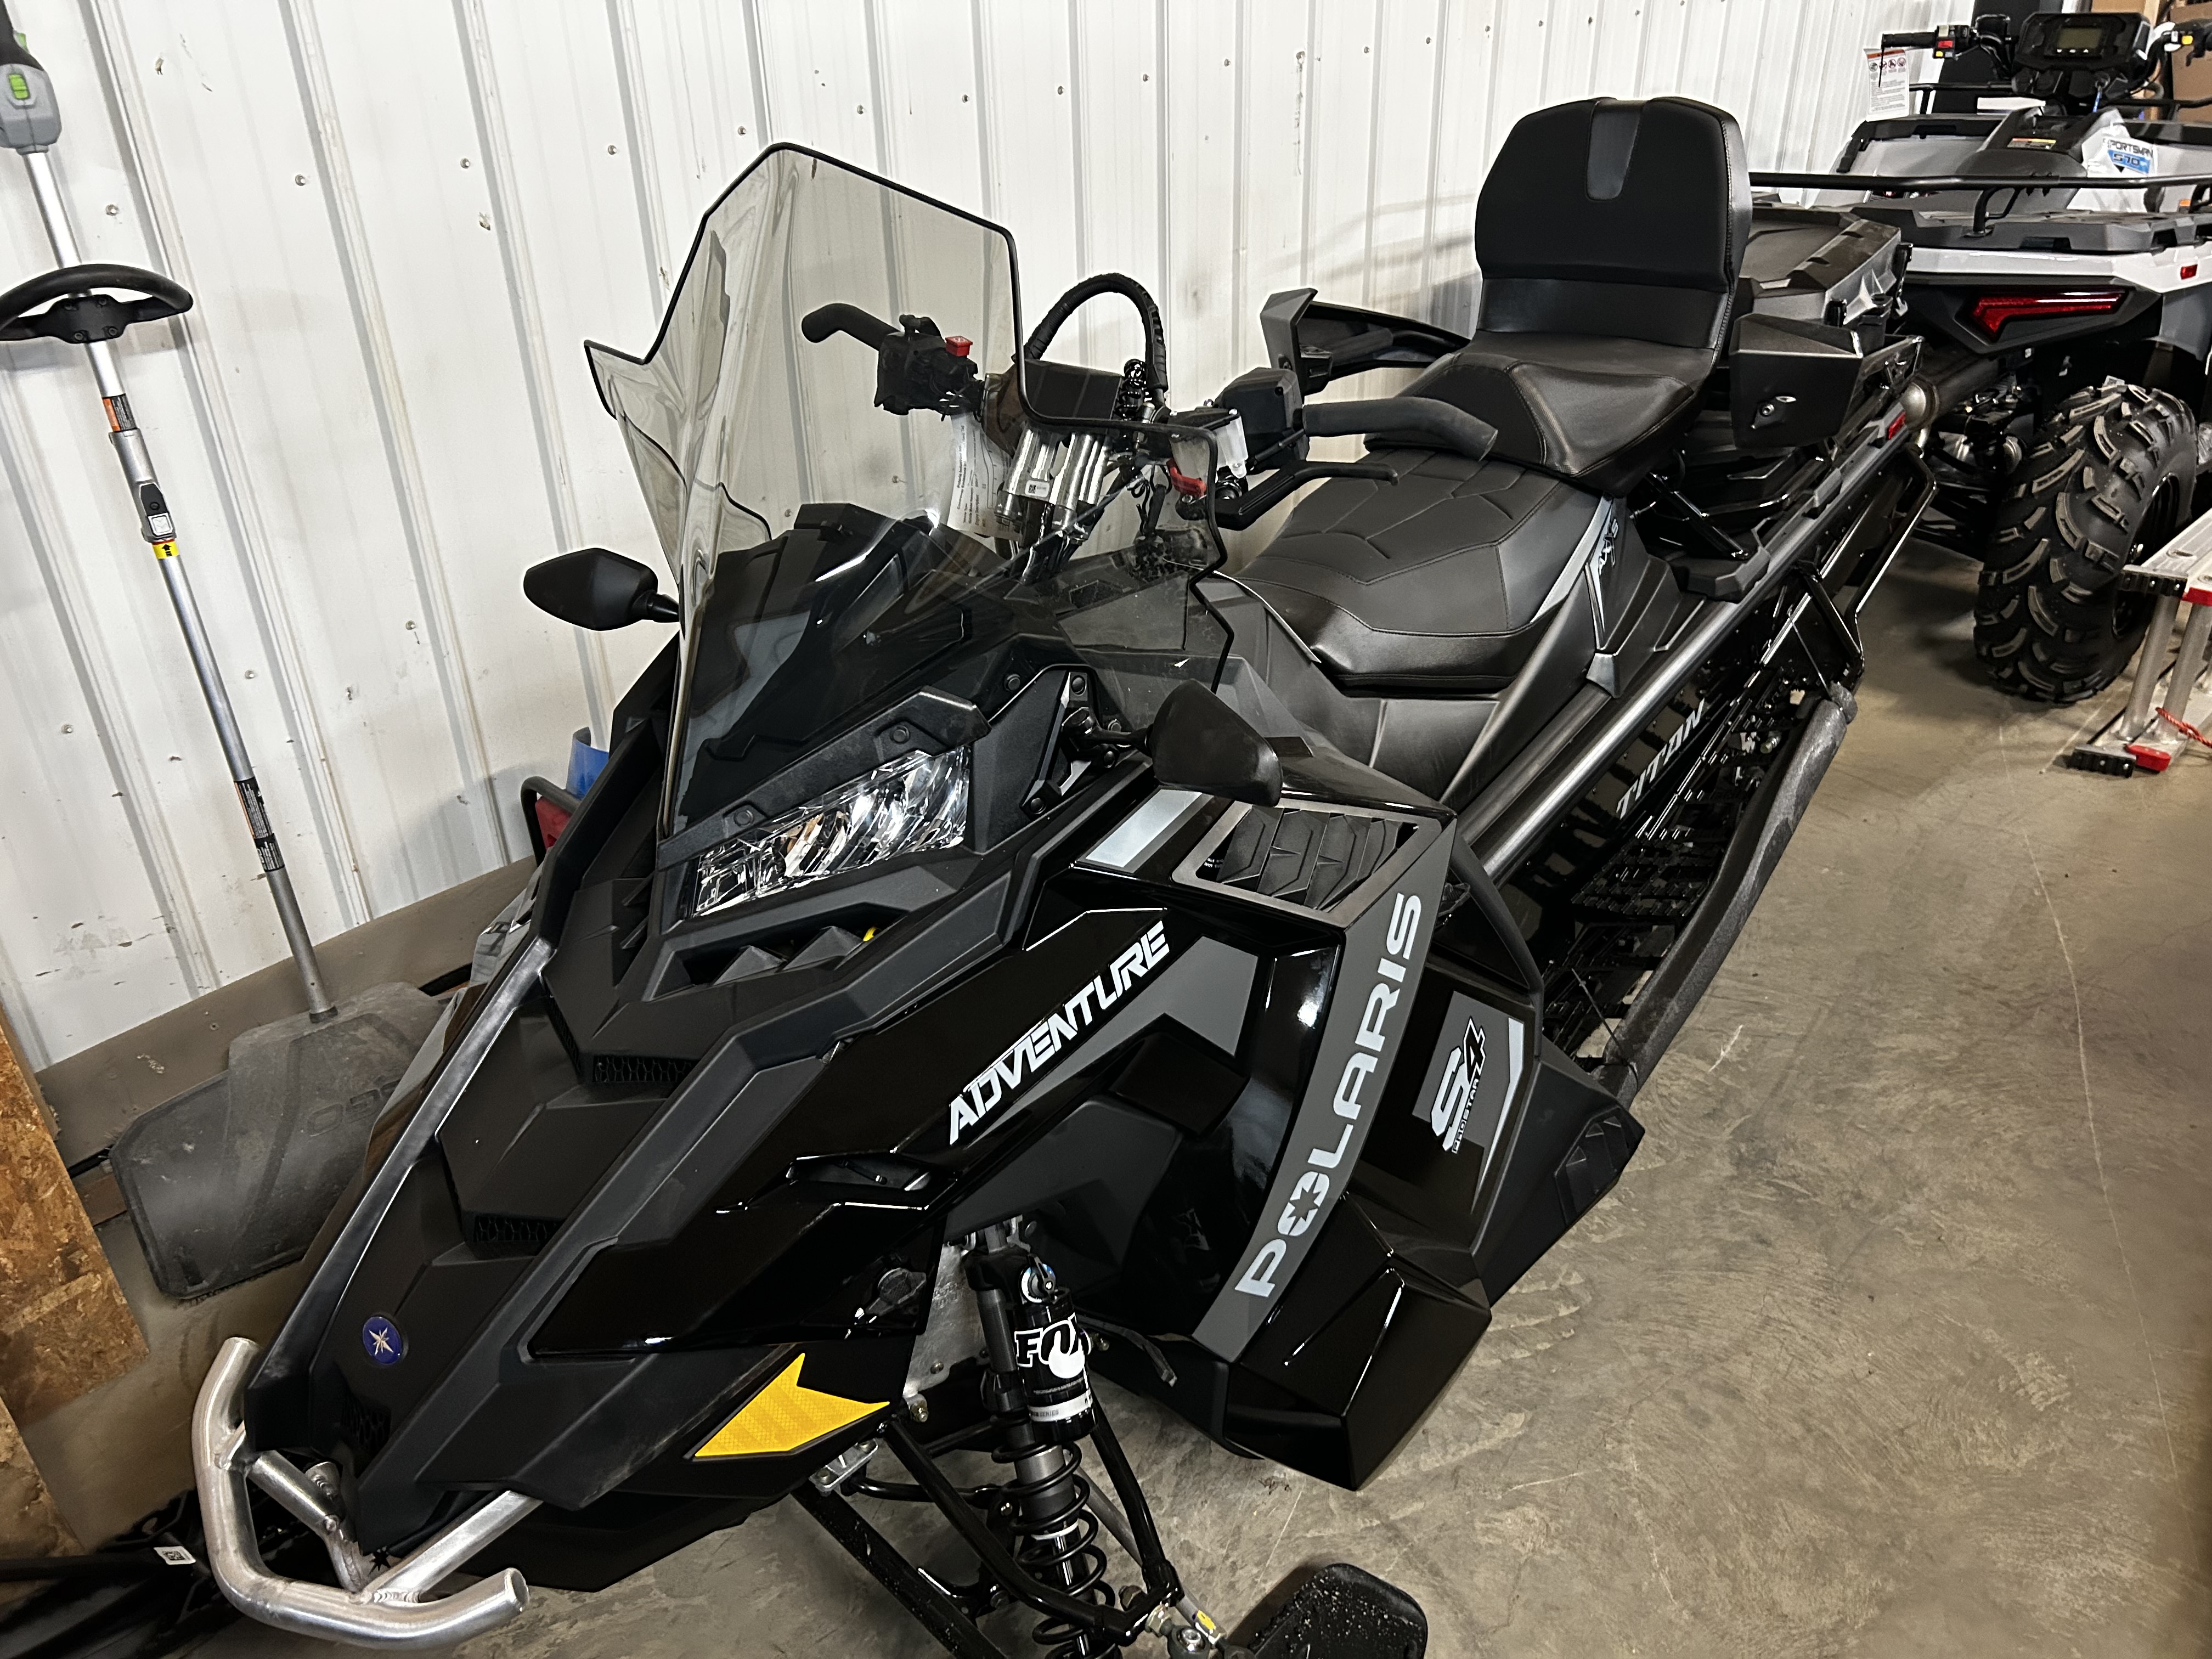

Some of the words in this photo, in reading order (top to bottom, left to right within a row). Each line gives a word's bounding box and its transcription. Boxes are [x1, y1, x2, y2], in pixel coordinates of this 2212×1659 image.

[1616, 697, 1705, 820] TITAN
[950, 920, 1170, 1145] ADVENTURE
[1235, 892, 1421, 1297] POLARIS
[1452, 1077, 1480, 1154] PROSTAR
